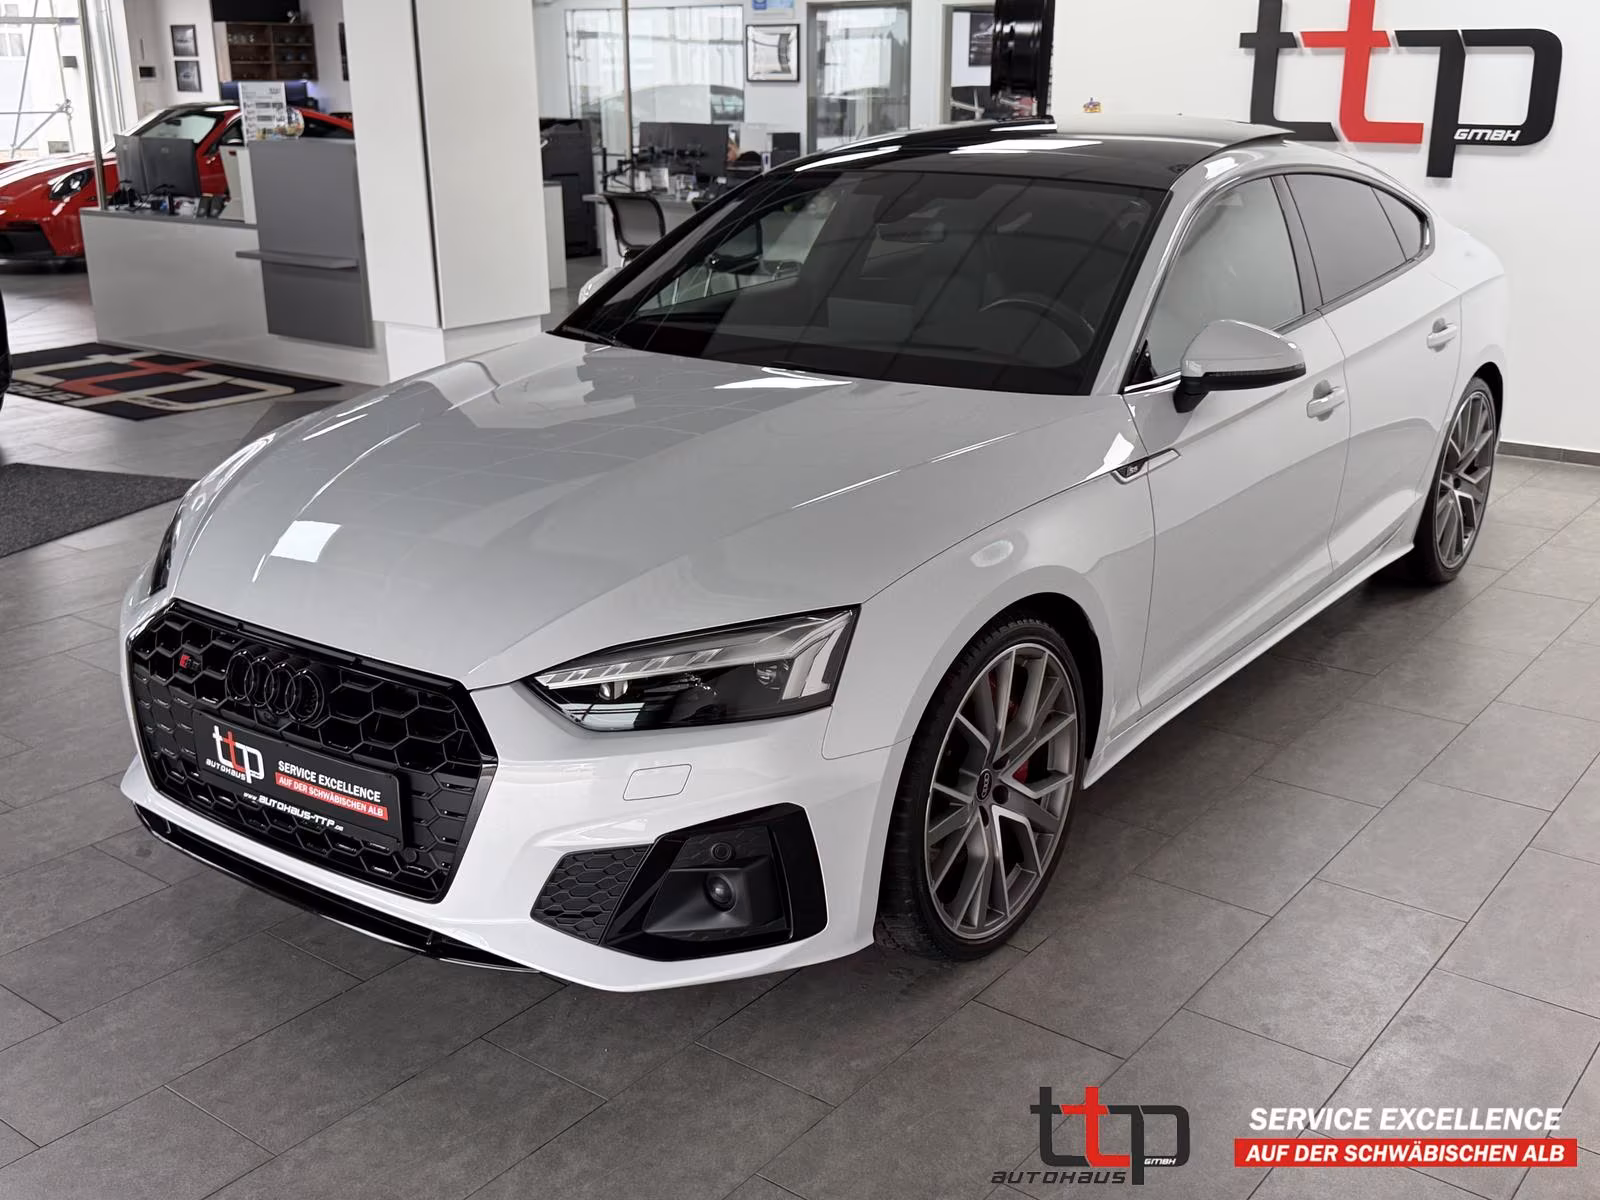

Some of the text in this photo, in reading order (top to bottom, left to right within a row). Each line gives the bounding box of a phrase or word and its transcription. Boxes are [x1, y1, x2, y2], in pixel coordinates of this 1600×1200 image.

[1239, 0, 1563, 178] ttp
[212, 725, 265, 784] ttp
[278, 760, 381, 802] SERVICE EXCELLENCE
[279, 776, 384, 817] AUF DER SCHWÄBISCHEN ALB
